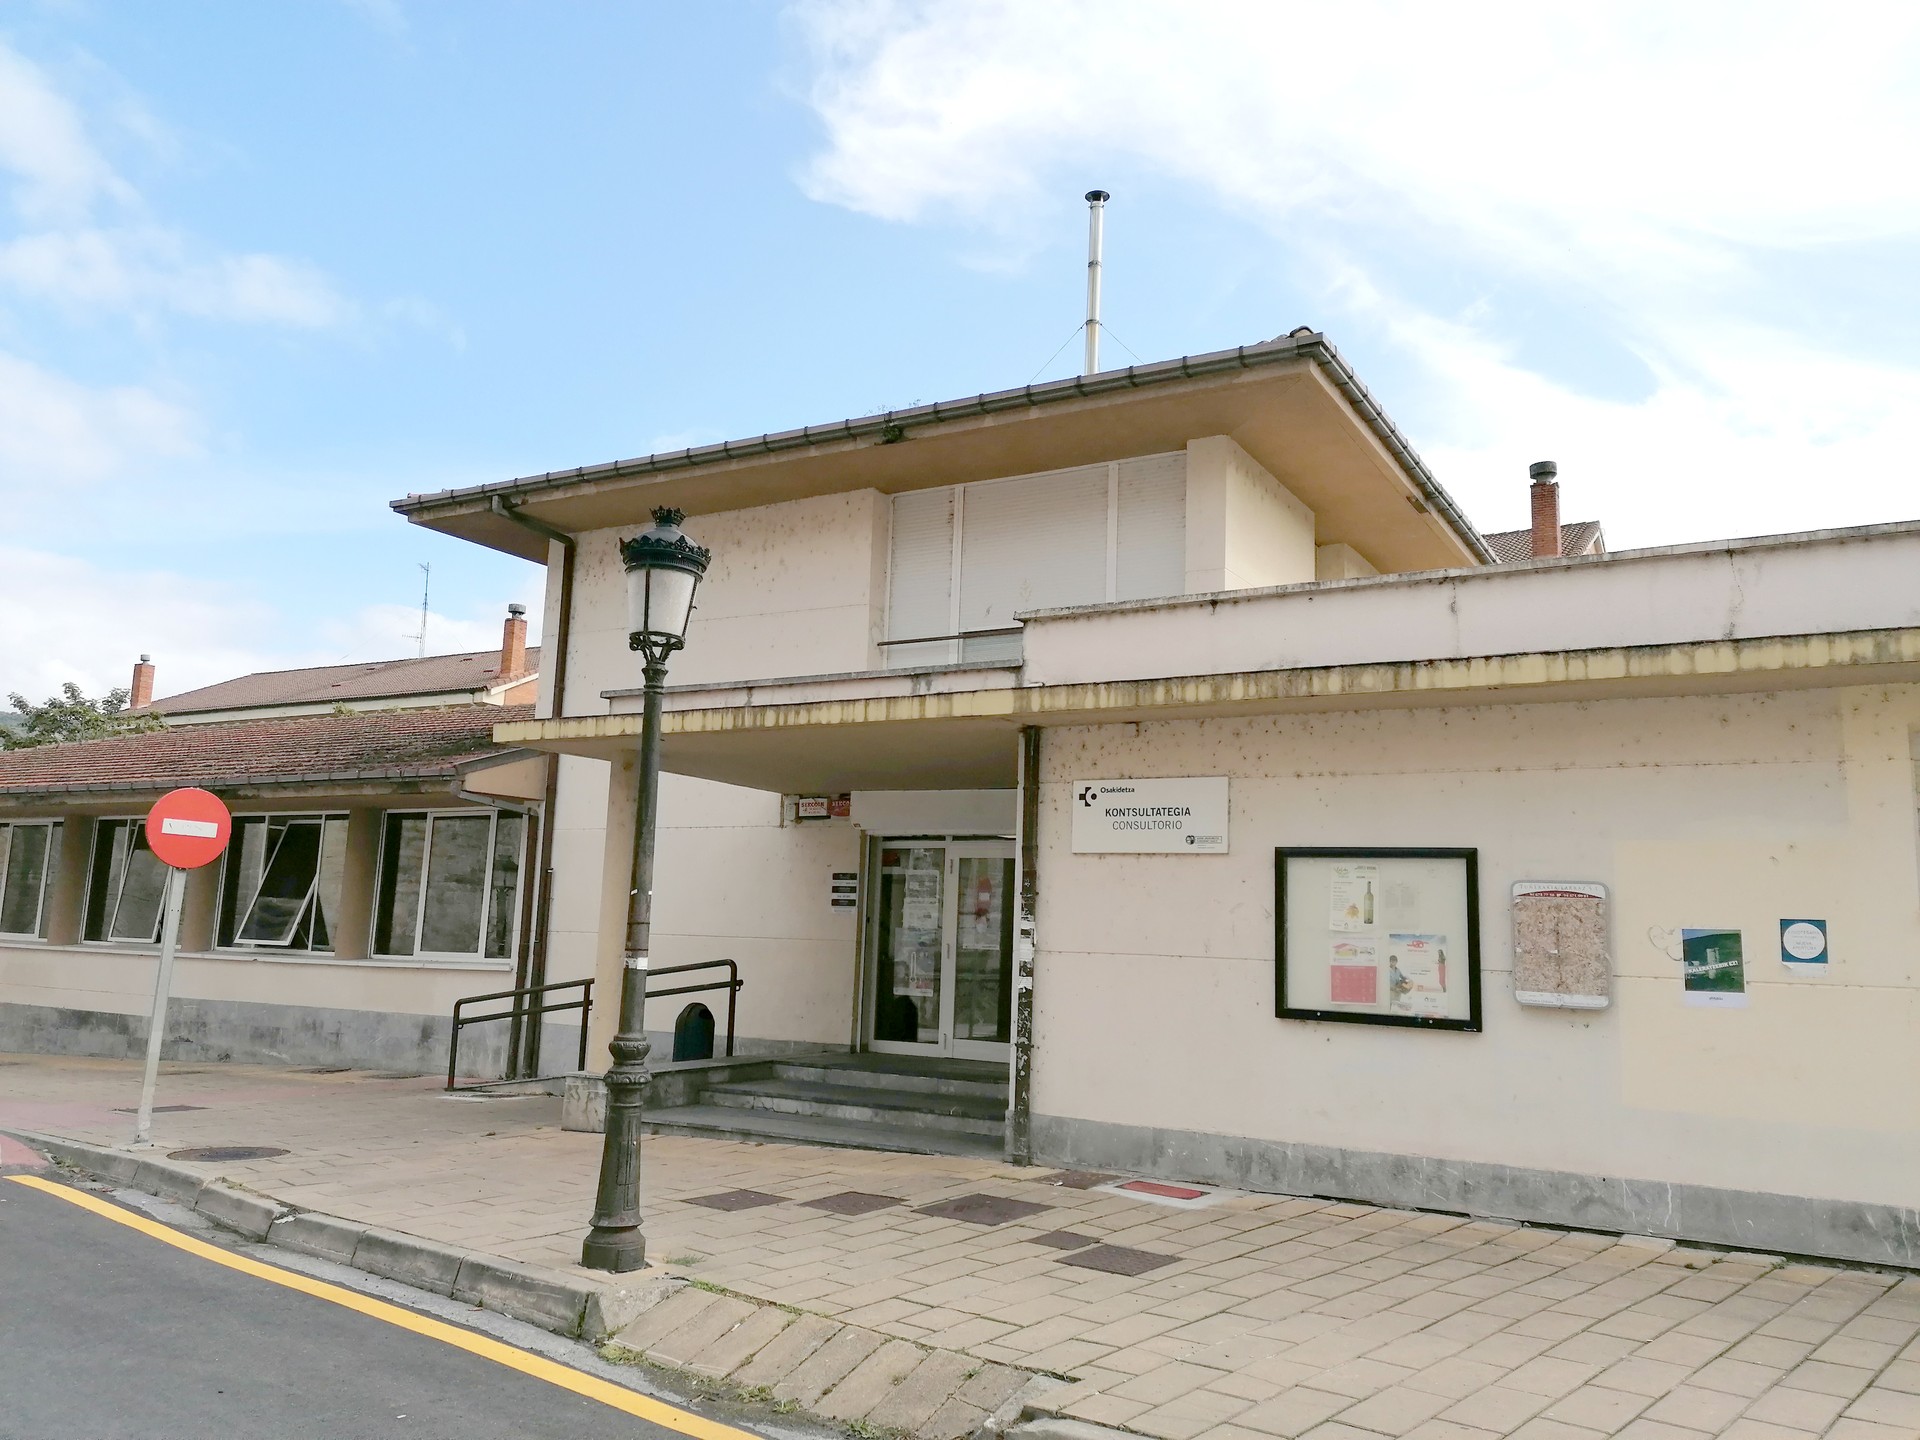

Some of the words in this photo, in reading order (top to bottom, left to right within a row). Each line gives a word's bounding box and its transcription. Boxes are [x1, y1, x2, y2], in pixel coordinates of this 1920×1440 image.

[1100, 786, 1135, 794] Osakidetza
[1105, 807, 1191, 818] KONTSULTATEGIA
[1112, 820, 1183, 830] CONSULTORIO
